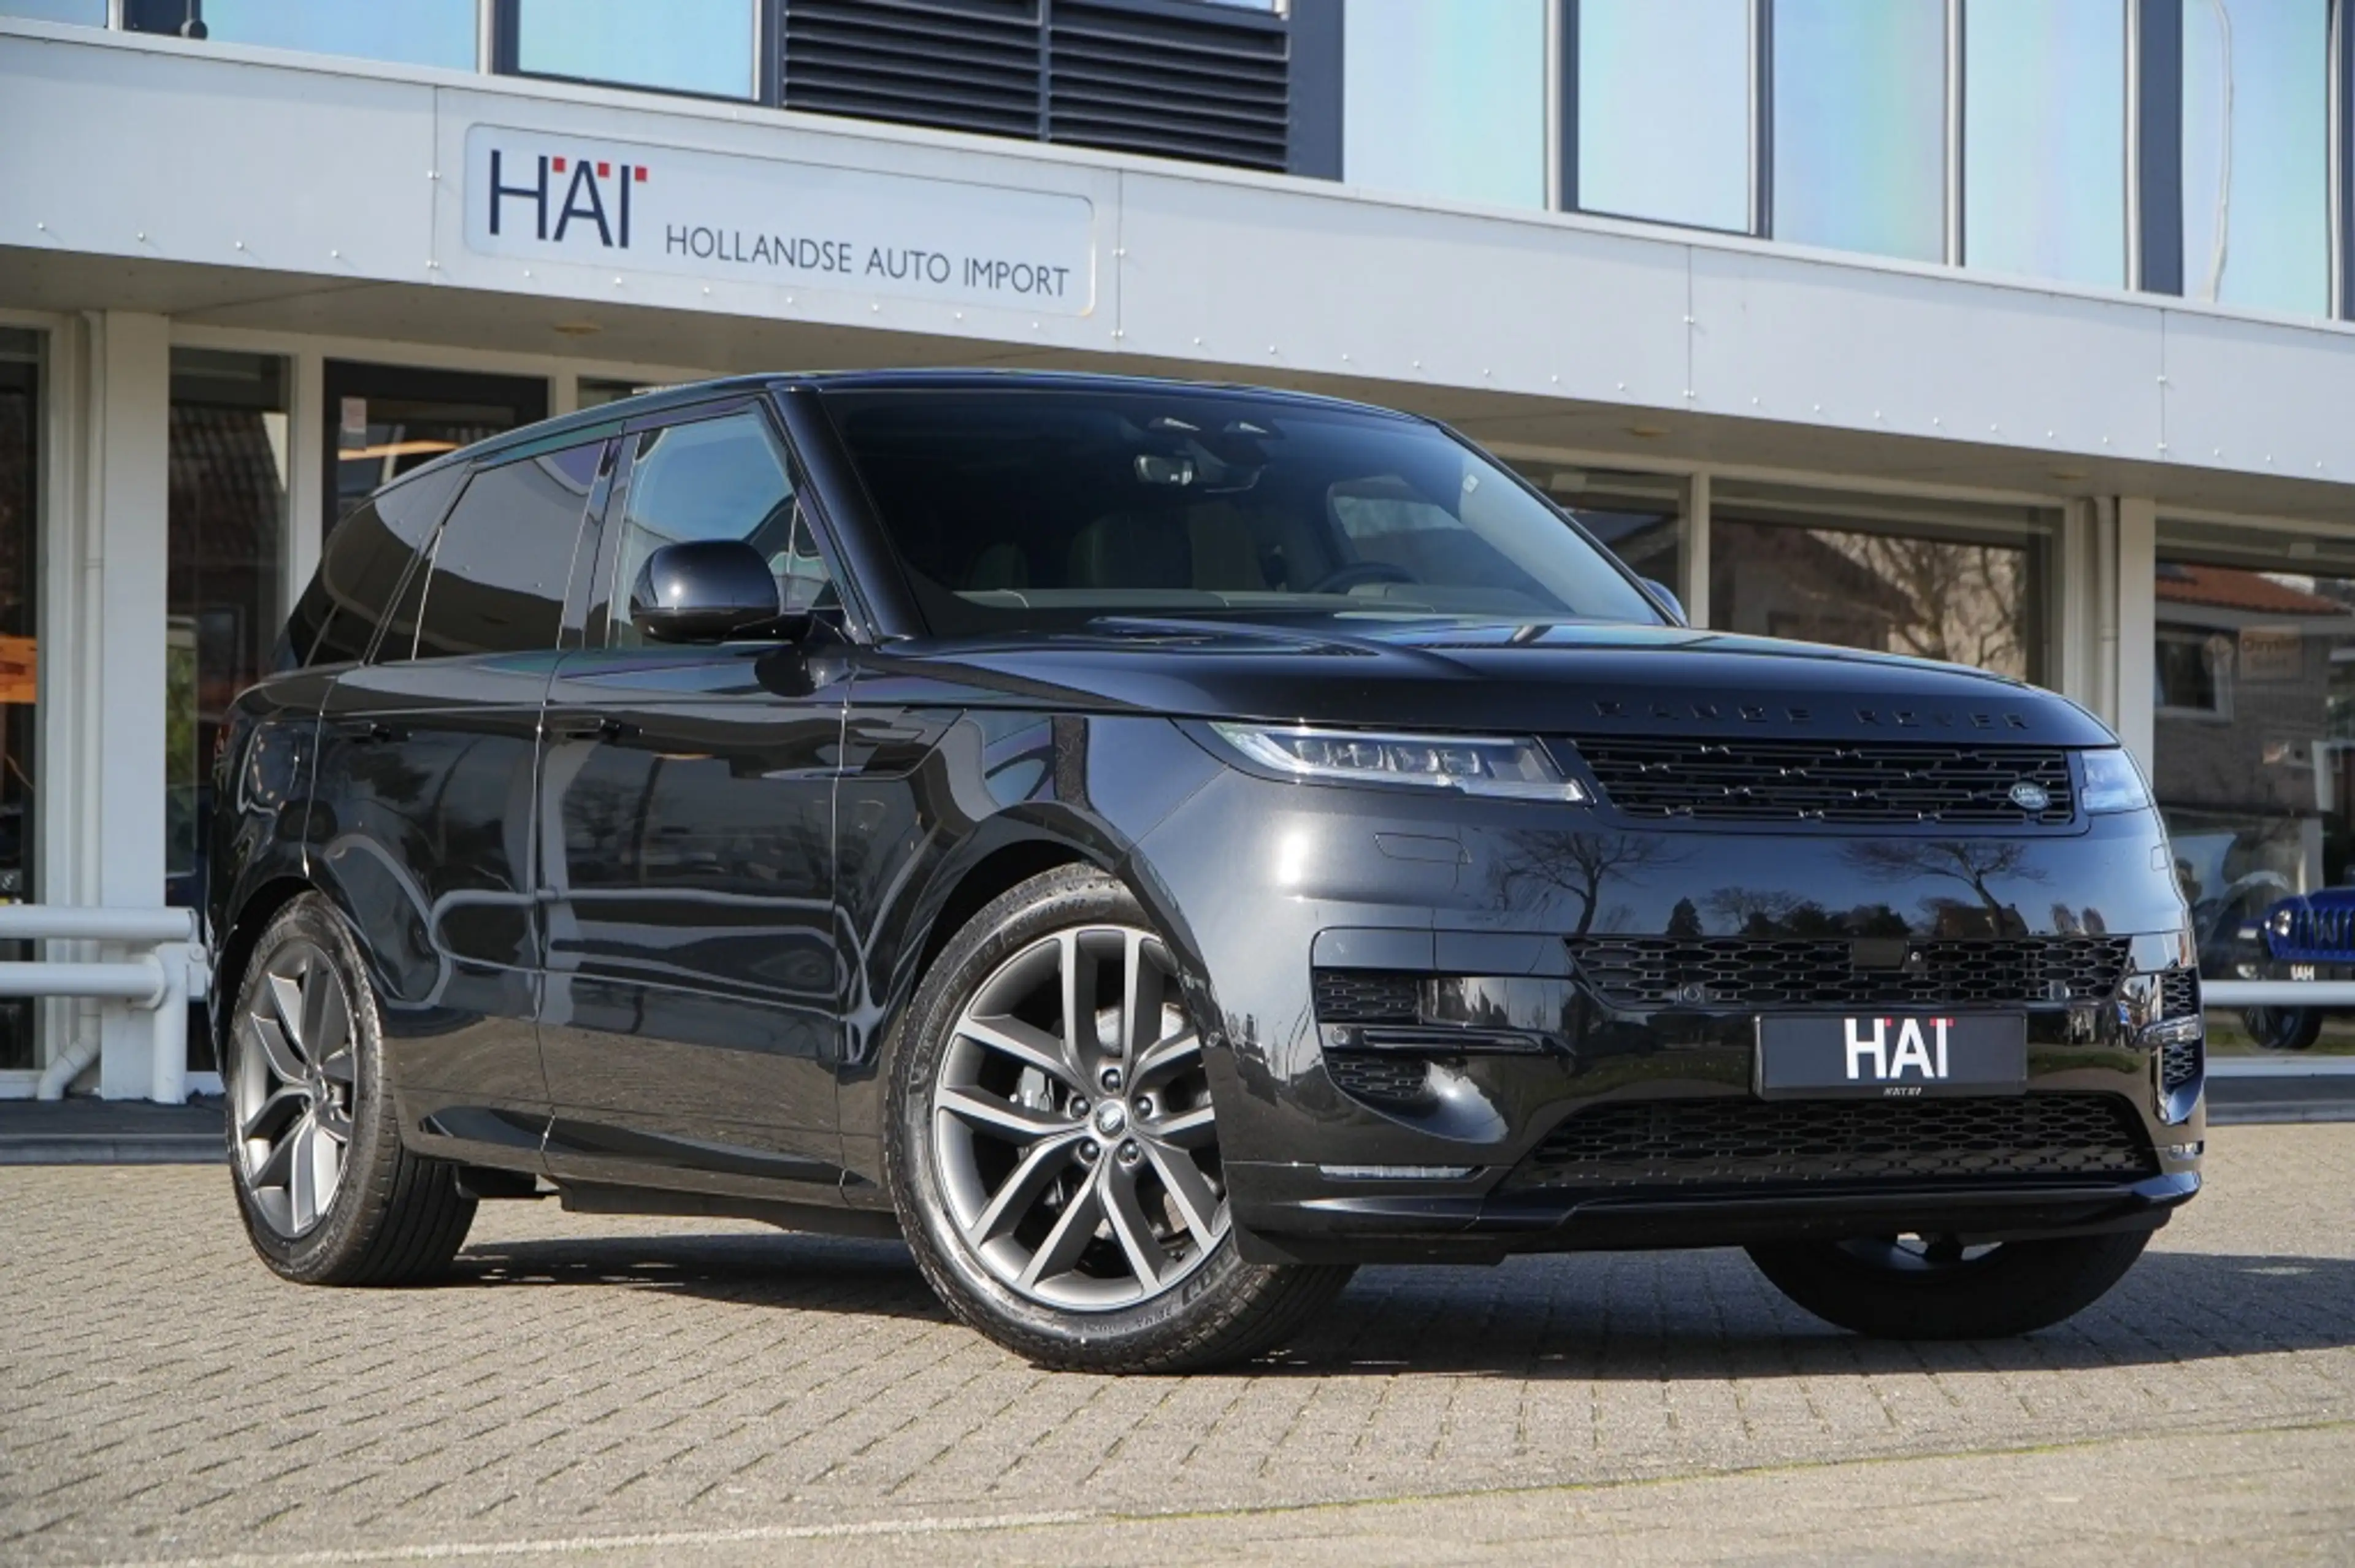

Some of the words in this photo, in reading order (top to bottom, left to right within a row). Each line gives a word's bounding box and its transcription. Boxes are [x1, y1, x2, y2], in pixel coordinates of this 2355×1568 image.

[666, 224, 852, 273] HOLLANDSE
[865, 247, 951, 284] AUTO
[964, 258, 1070, 297] IMPORT
